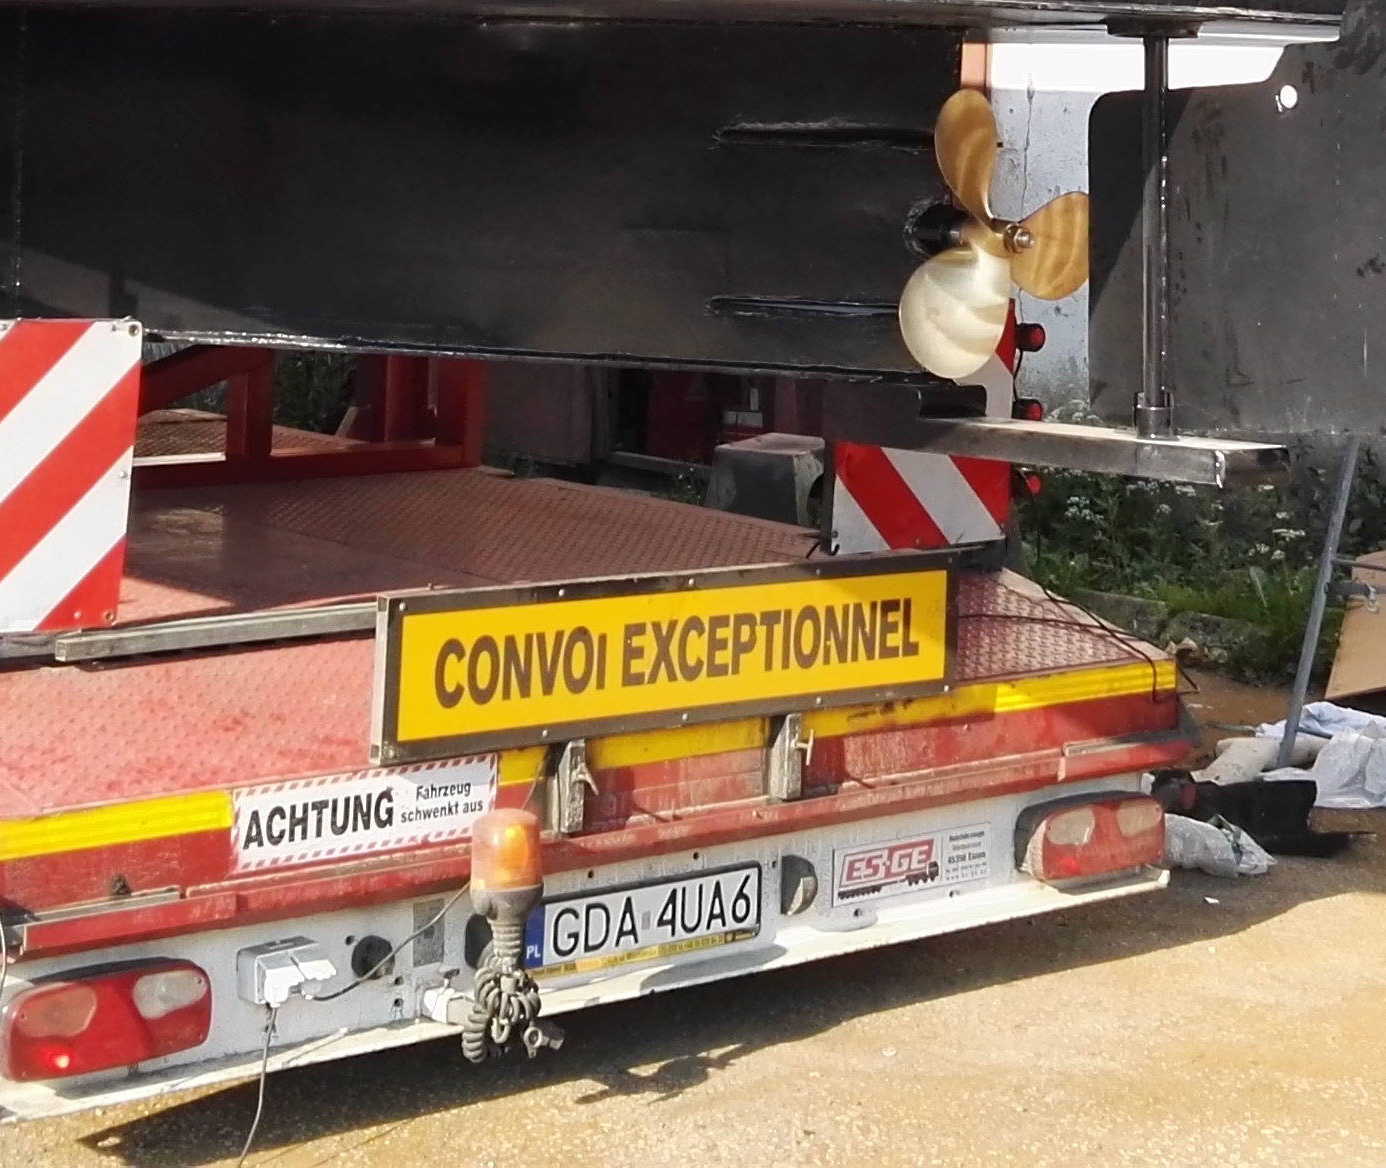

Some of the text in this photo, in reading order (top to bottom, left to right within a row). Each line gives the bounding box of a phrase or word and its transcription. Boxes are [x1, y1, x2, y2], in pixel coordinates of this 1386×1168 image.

[622, 597, 920, 688] EXCEPTIONNEL
[401, 798, 484, 823] schwenkt aus
[416, 781, 471, 801] Fahrzeug
[242, 787, 394, 850] ACHTUNG
[552, 896, 639, 958] GDA
[656, 874, 751, 938] 4UA6
[525, 944, 541, 960] PL
